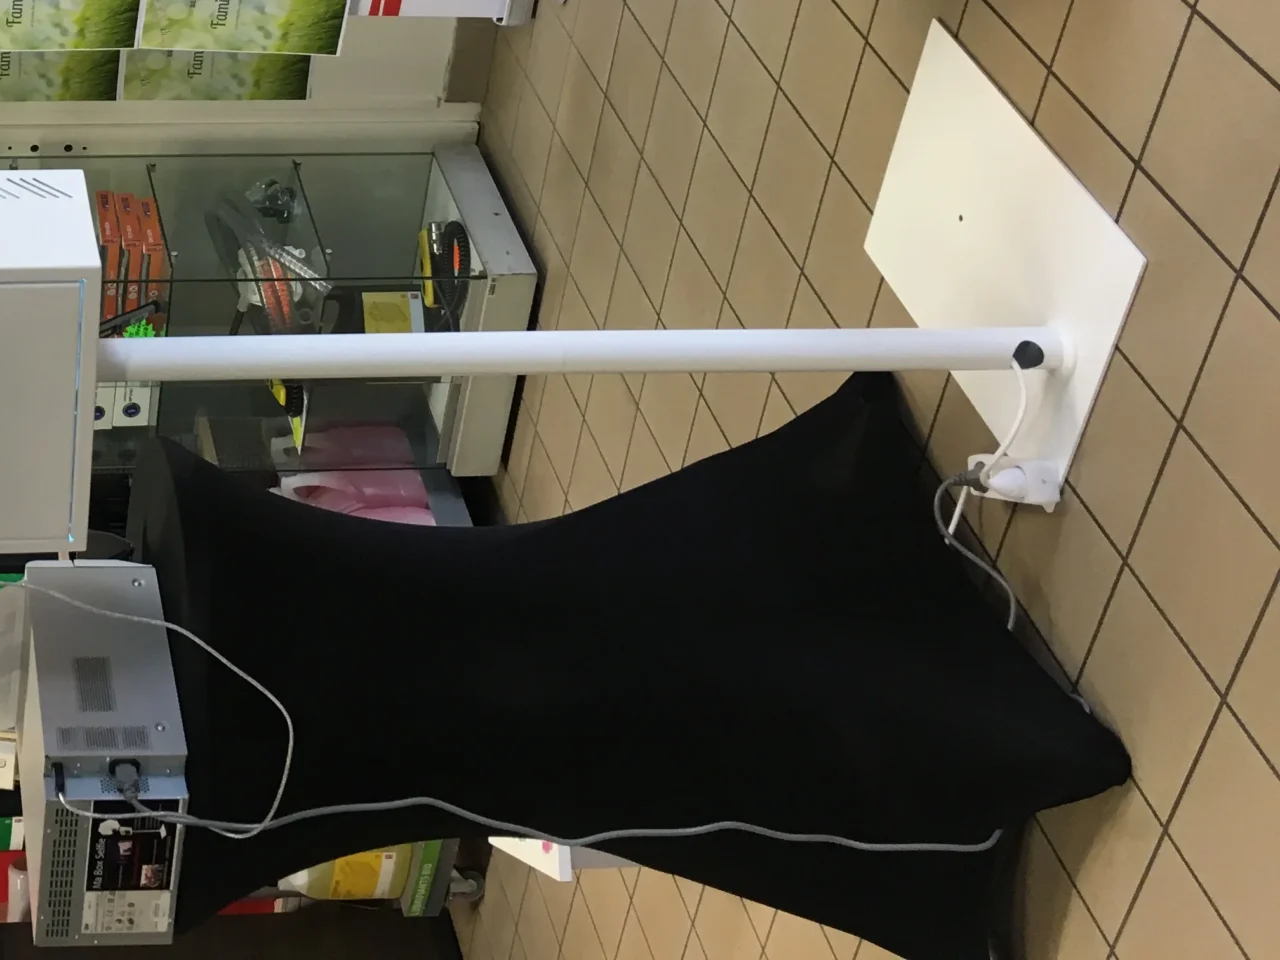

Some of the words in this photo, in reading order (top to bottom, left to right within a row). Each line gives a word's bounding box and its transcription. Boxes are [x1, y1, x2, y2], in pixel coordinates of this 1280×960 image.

[95, 838, 106, 859] Selfie
[94, 861, 104, 875] Box
[93, 878, 103, 888] Ma
